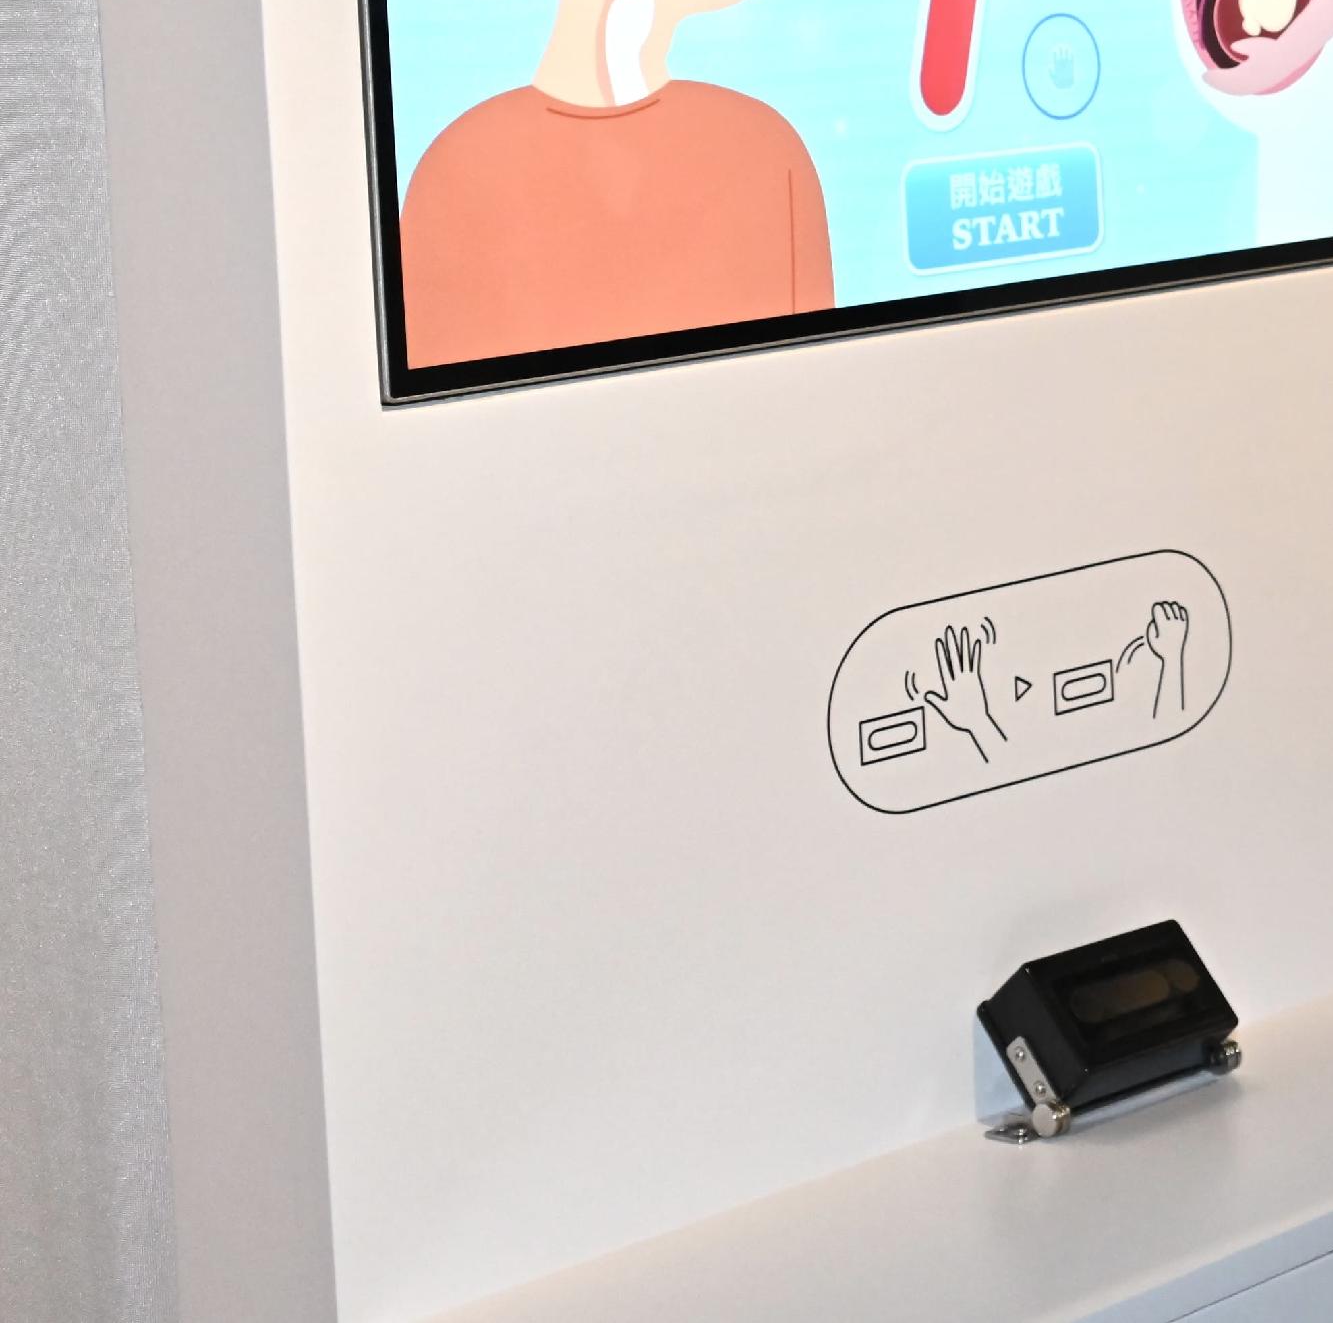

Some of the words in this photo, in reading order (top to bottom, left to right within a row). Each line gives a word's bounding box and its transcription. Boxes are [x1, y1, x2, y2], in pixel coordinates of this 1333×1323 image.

[949, 164, 1063, 210] 開始遊戲
[952, 208, 1064, 251] START
